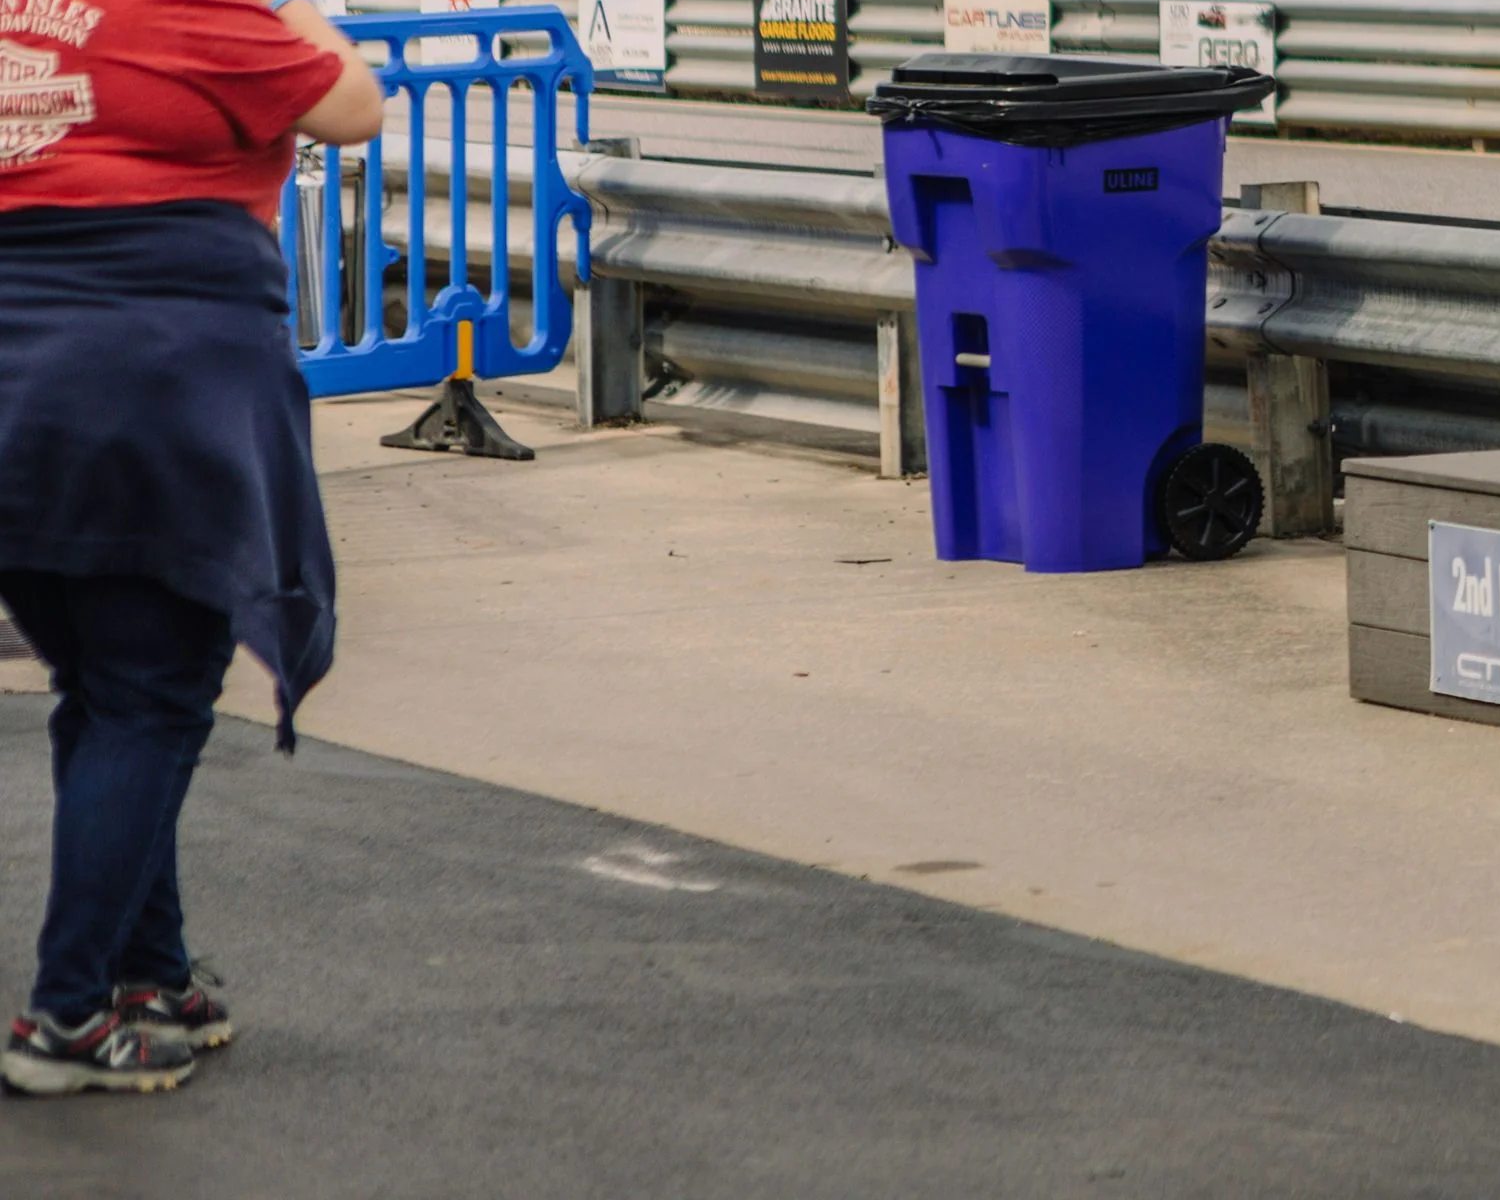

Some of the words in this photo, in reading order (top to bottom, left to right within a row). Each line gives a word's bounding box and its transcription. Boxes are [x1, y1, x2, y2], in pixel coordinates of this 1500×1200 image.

[947, 8, 1046, 30] CARTUNES
[760, 21, 798, 40] GARAGE
[798, 22, 836, 41] FLOORS
[1108, 171, 1157, 190] ULINE
[1451, 556, 1493, 618] 2nd
